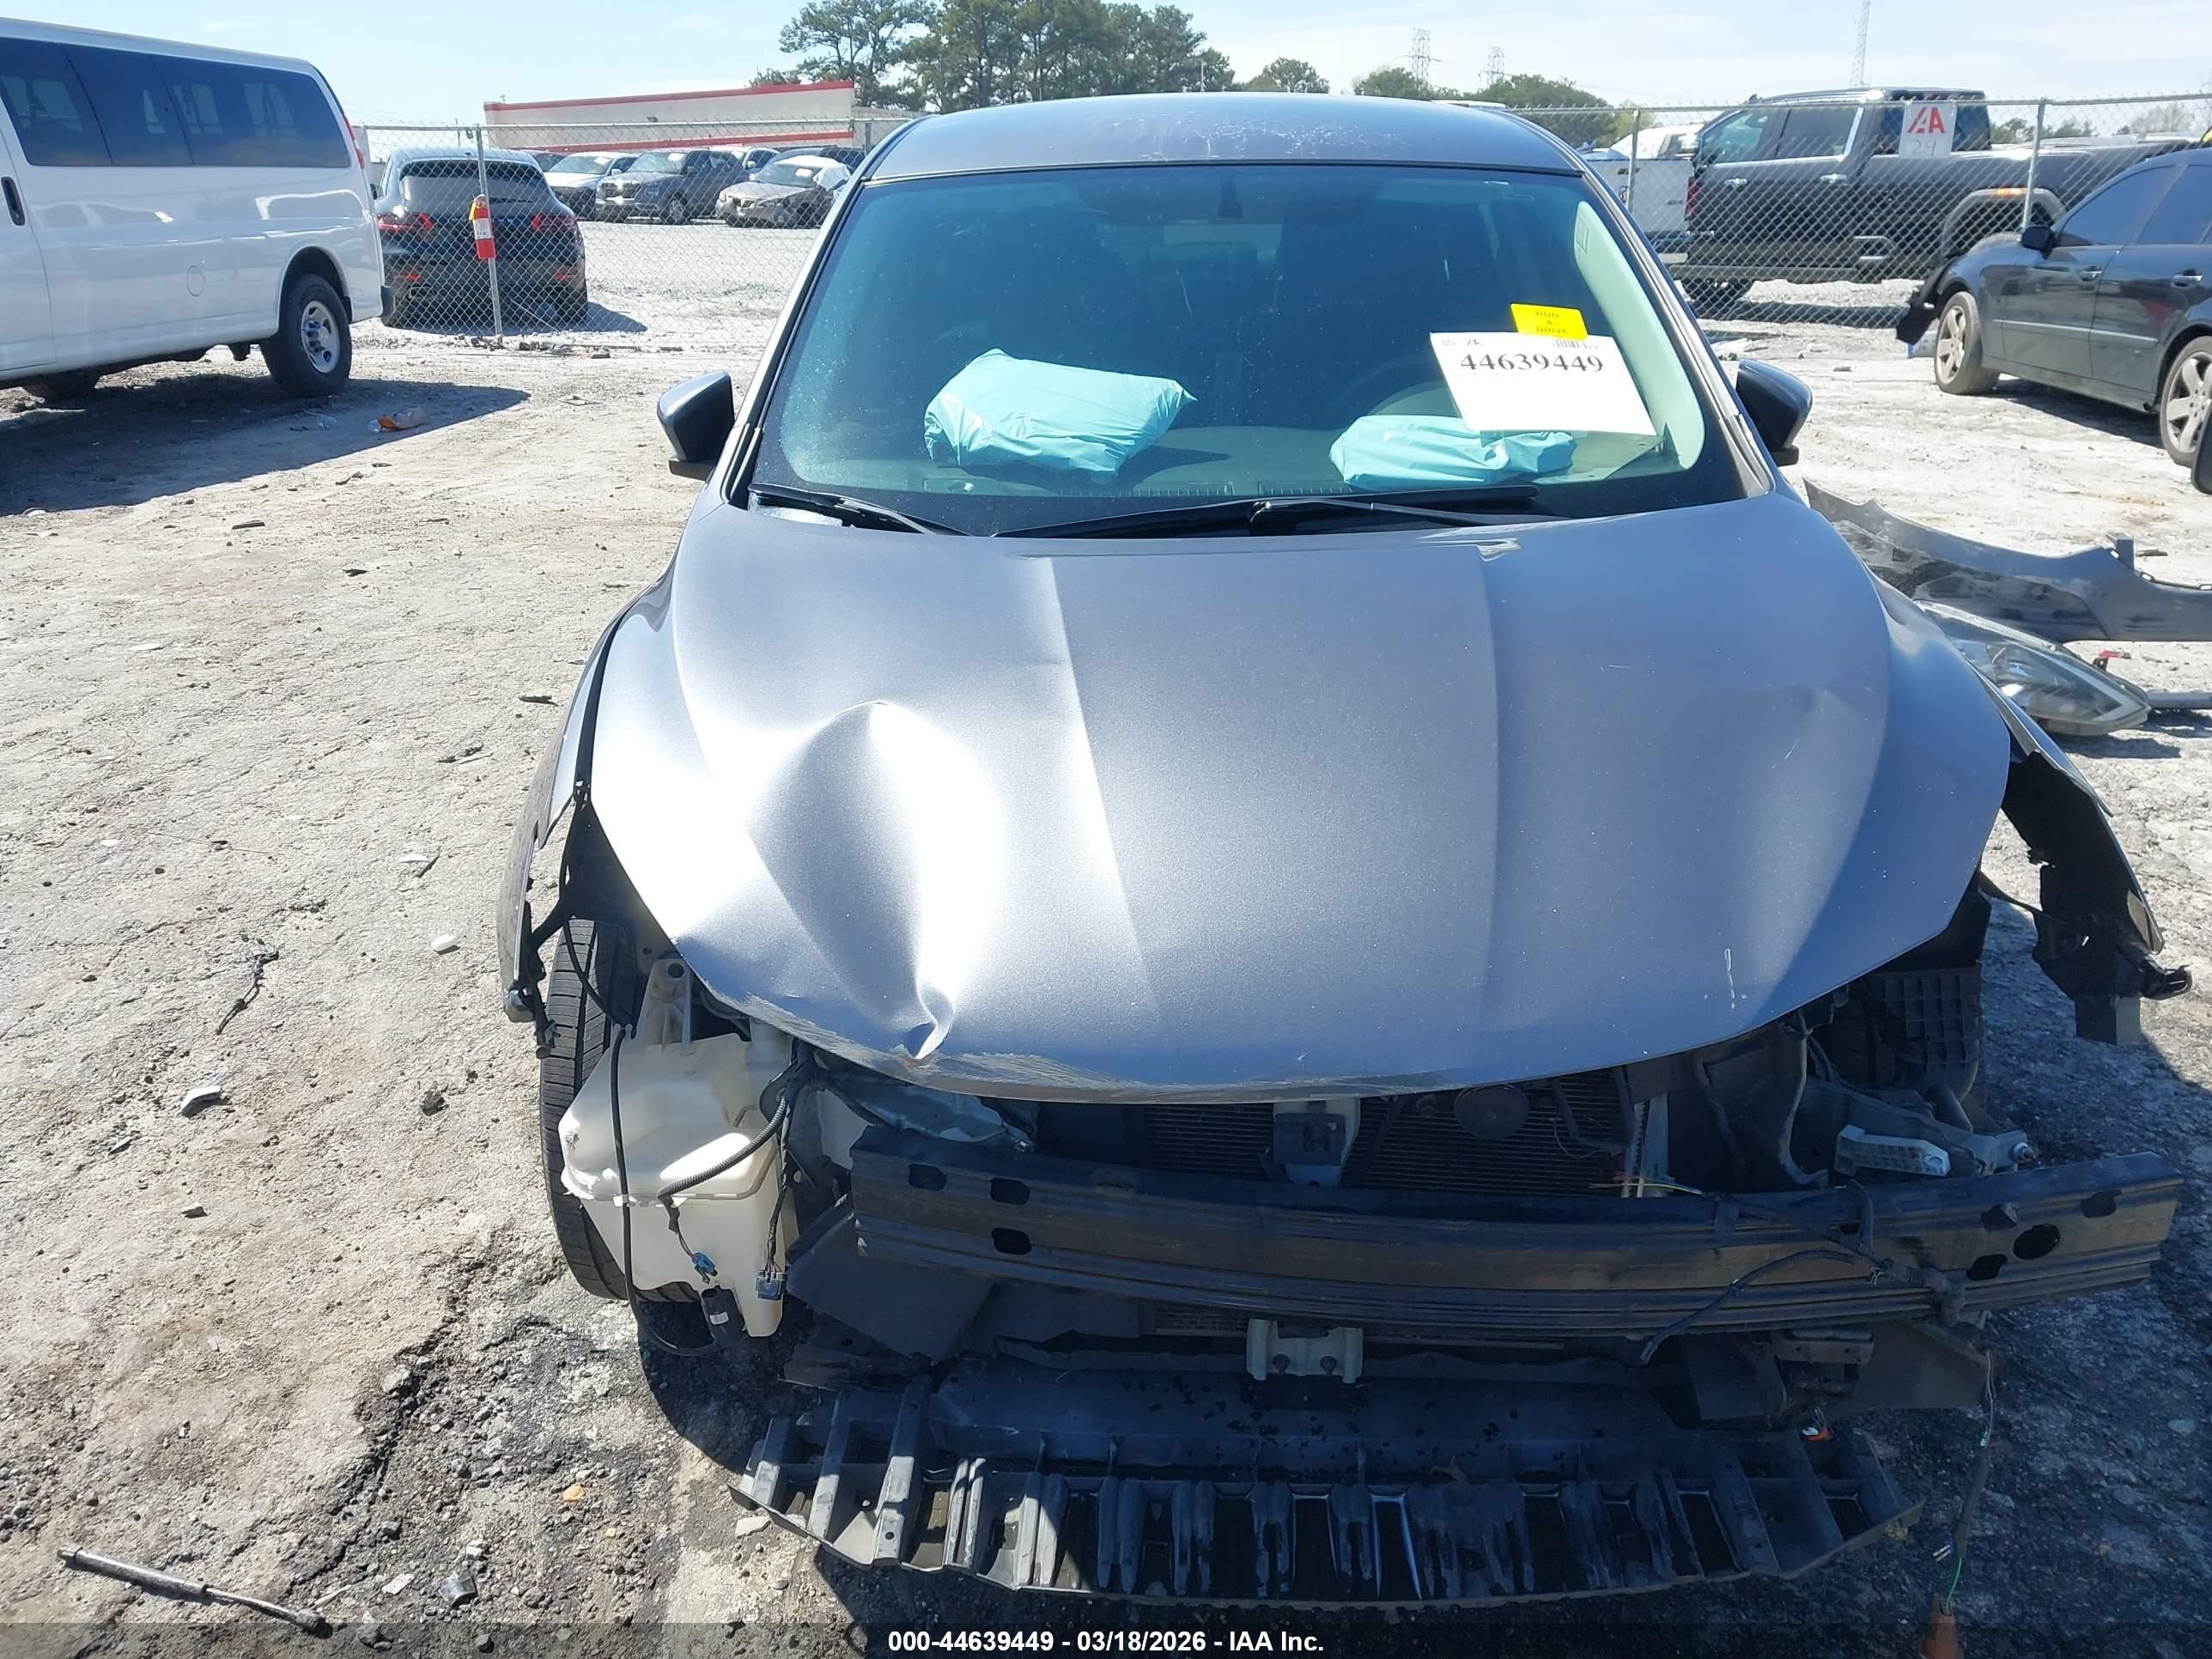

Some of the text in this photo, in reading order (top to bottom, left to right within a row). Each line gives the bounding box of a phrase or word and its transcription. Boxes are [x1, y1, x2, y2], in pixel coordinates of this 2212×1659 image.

[1534, 310, 1559, 319] RUN
[1535, 325, 1570, 335] DRIVE
[1460, 353, 1604, 373] 44639449
